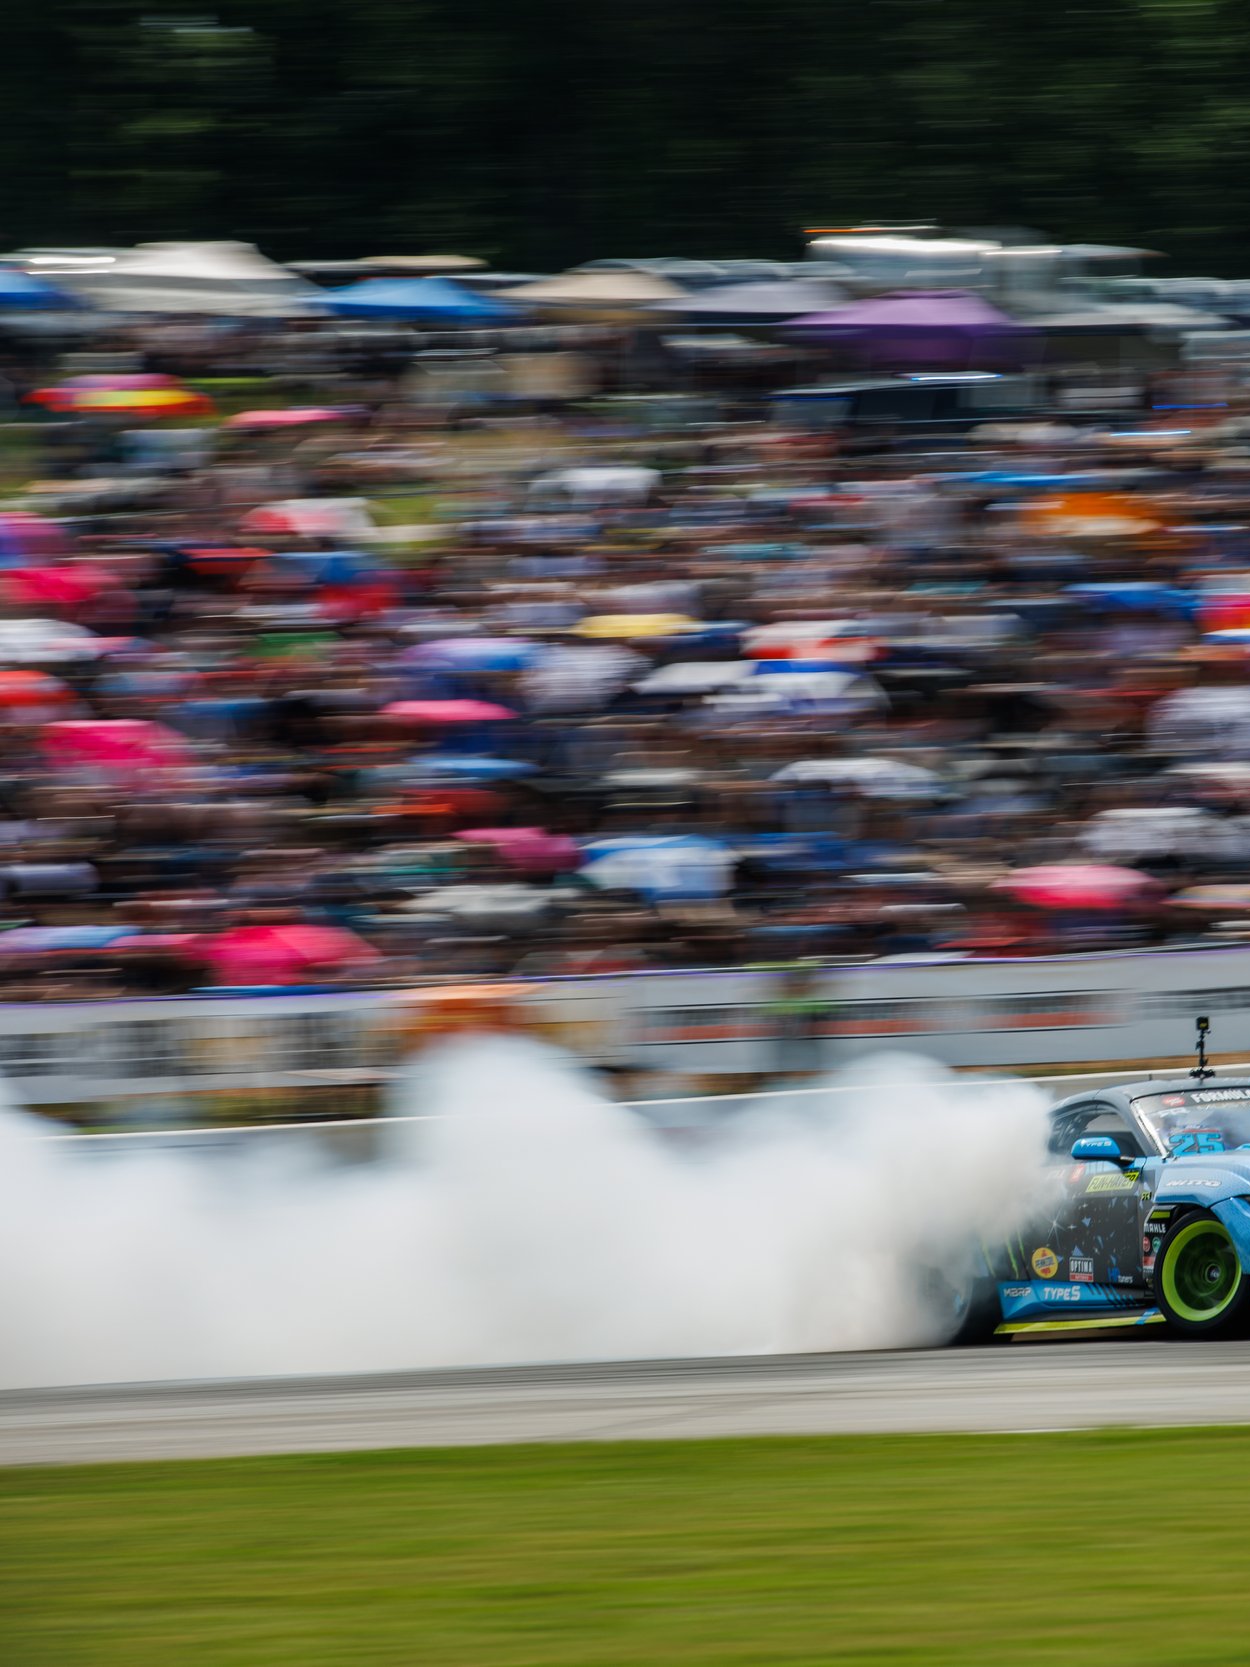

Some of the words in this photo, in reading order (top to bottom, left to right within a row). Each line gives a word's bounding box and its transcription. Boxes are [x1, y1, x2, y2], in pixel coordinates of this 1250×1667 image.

[1168, 1132, 1225, 1156] 25
[1166, 1180, 1222, 1188] NITTO
[1144, 1223, 1166, 1233] MAHLE
[1070, 1260, 1093, 1273] OPTIMA
